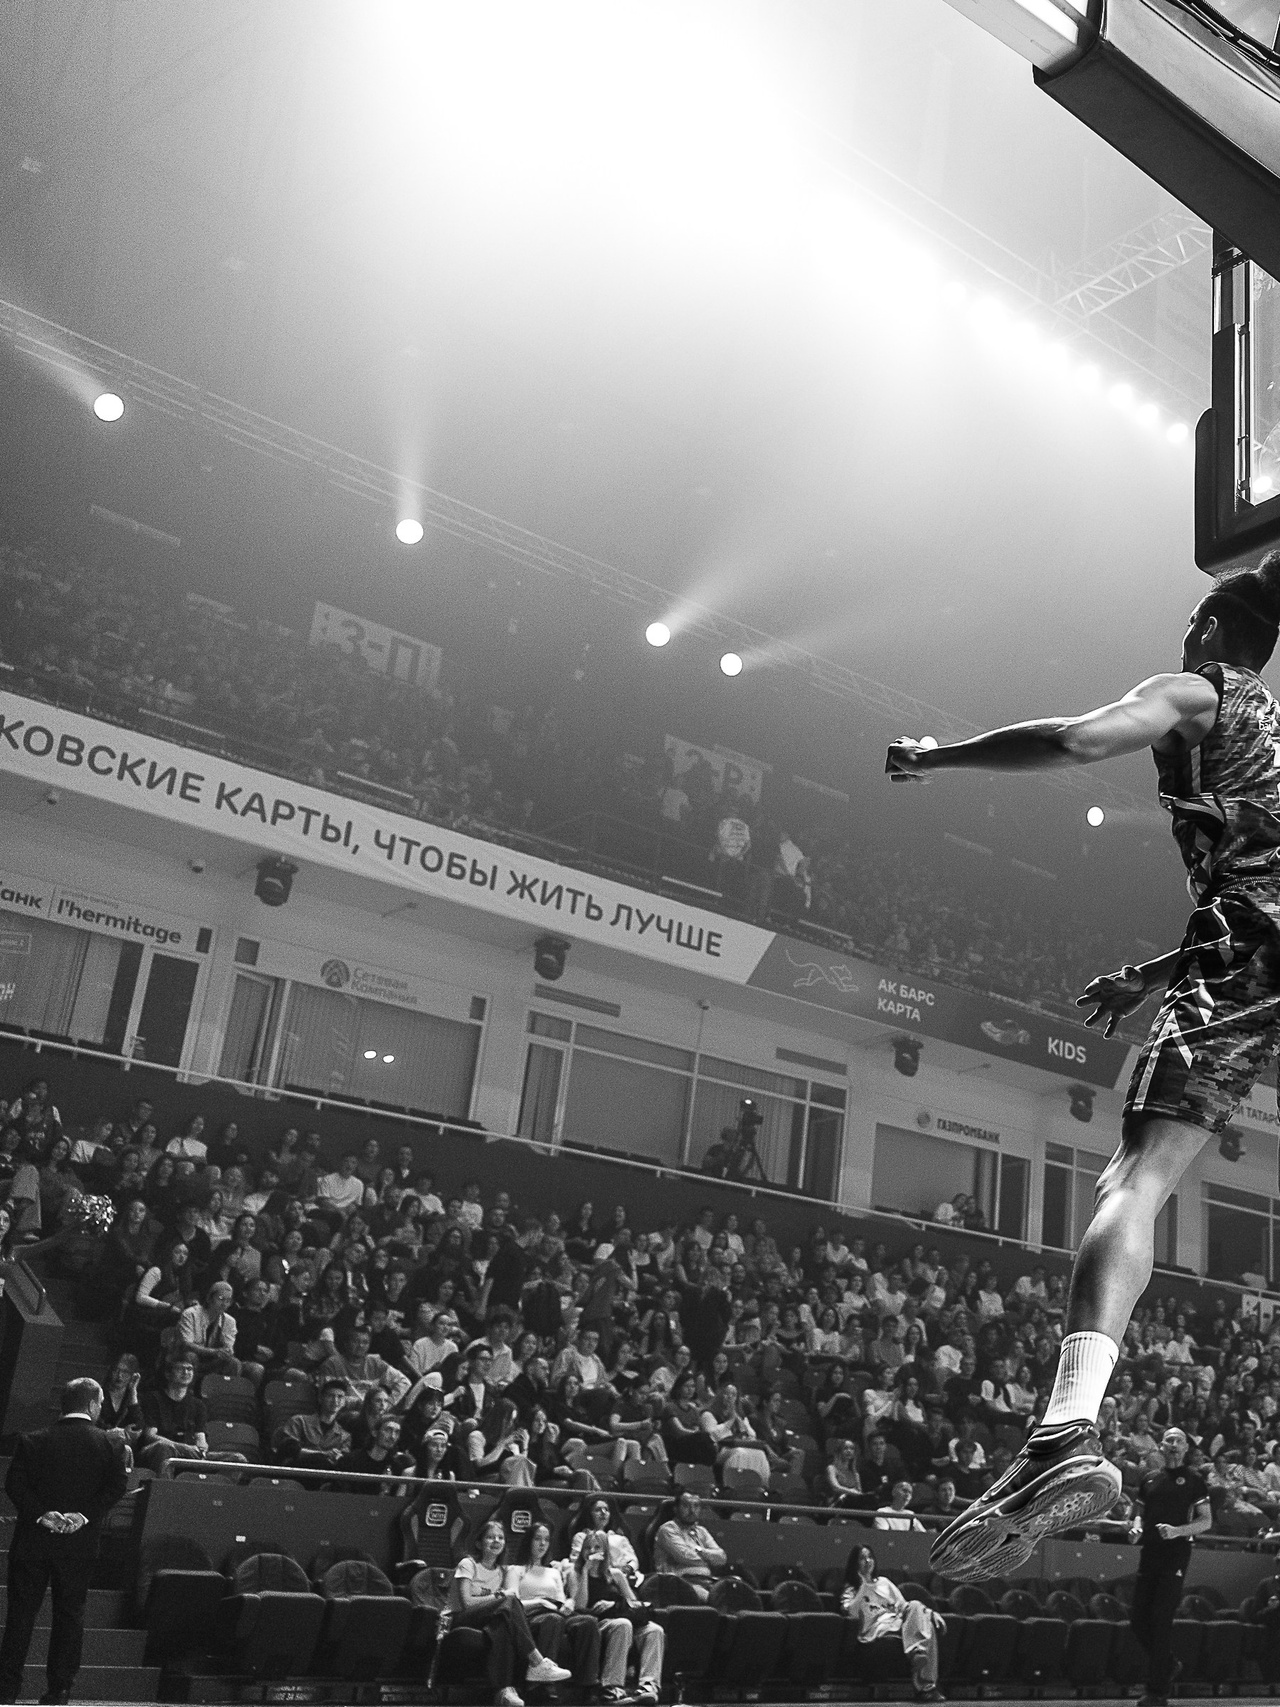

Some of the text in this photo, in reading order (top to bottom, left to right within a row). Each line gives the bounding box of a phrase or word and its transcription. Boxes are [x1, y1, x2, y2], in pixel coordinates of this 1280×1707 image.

[215, 782, 360, 855] КАРТЫ,
[374, 829, 497, 890] ЧТОБЫ
[506, 870, 603, 921] ЖИТЬ
[610, 903, 723, 957] ЛУЧШЕ
[0, 880, 42, 909] анк
[57, 897, 182, 945] l'hermitage
[878, 979, 935, 1006] АК БАРС
[877, 998, 921, 1022] КАРТА
[1048, 1036, 1086, 1063] KIDS
